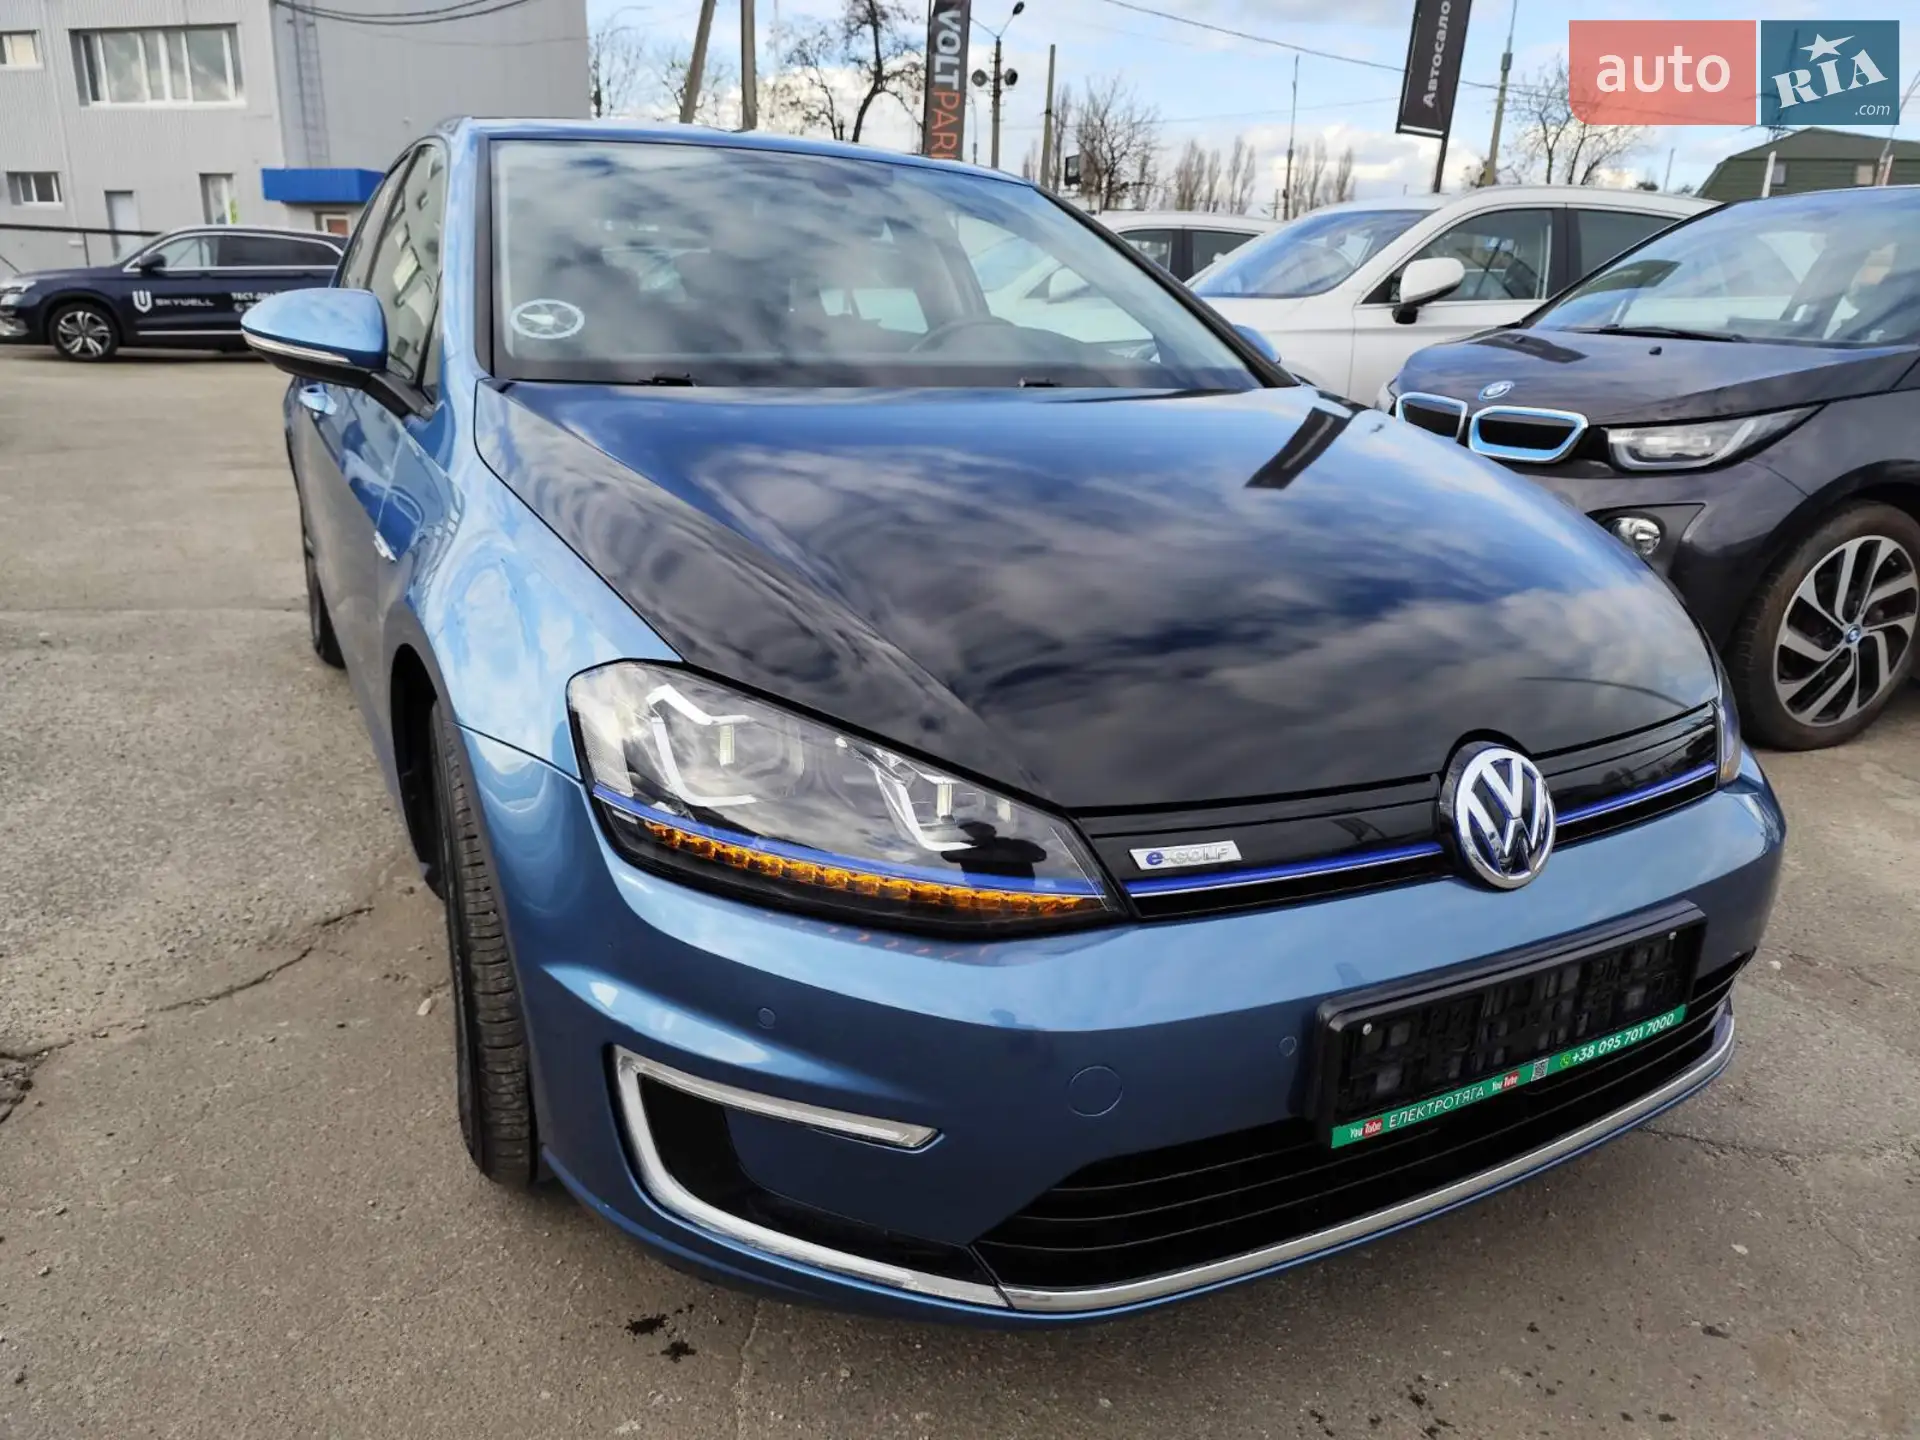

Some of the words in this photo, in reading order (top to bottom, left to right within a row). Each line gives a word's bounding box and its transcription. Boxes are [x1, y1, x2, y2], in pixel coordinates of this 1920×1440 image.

[1389, 1086, 1484, 1128] ЕЛЕКТРОТЯГА
[1572, 1045, 1596, 1062] +38
[1598, 1036, 1622, 1054] 095
[1624, 1026, 1644, 1044] 701
[1646, 1013, 1674, 1035] 7000
